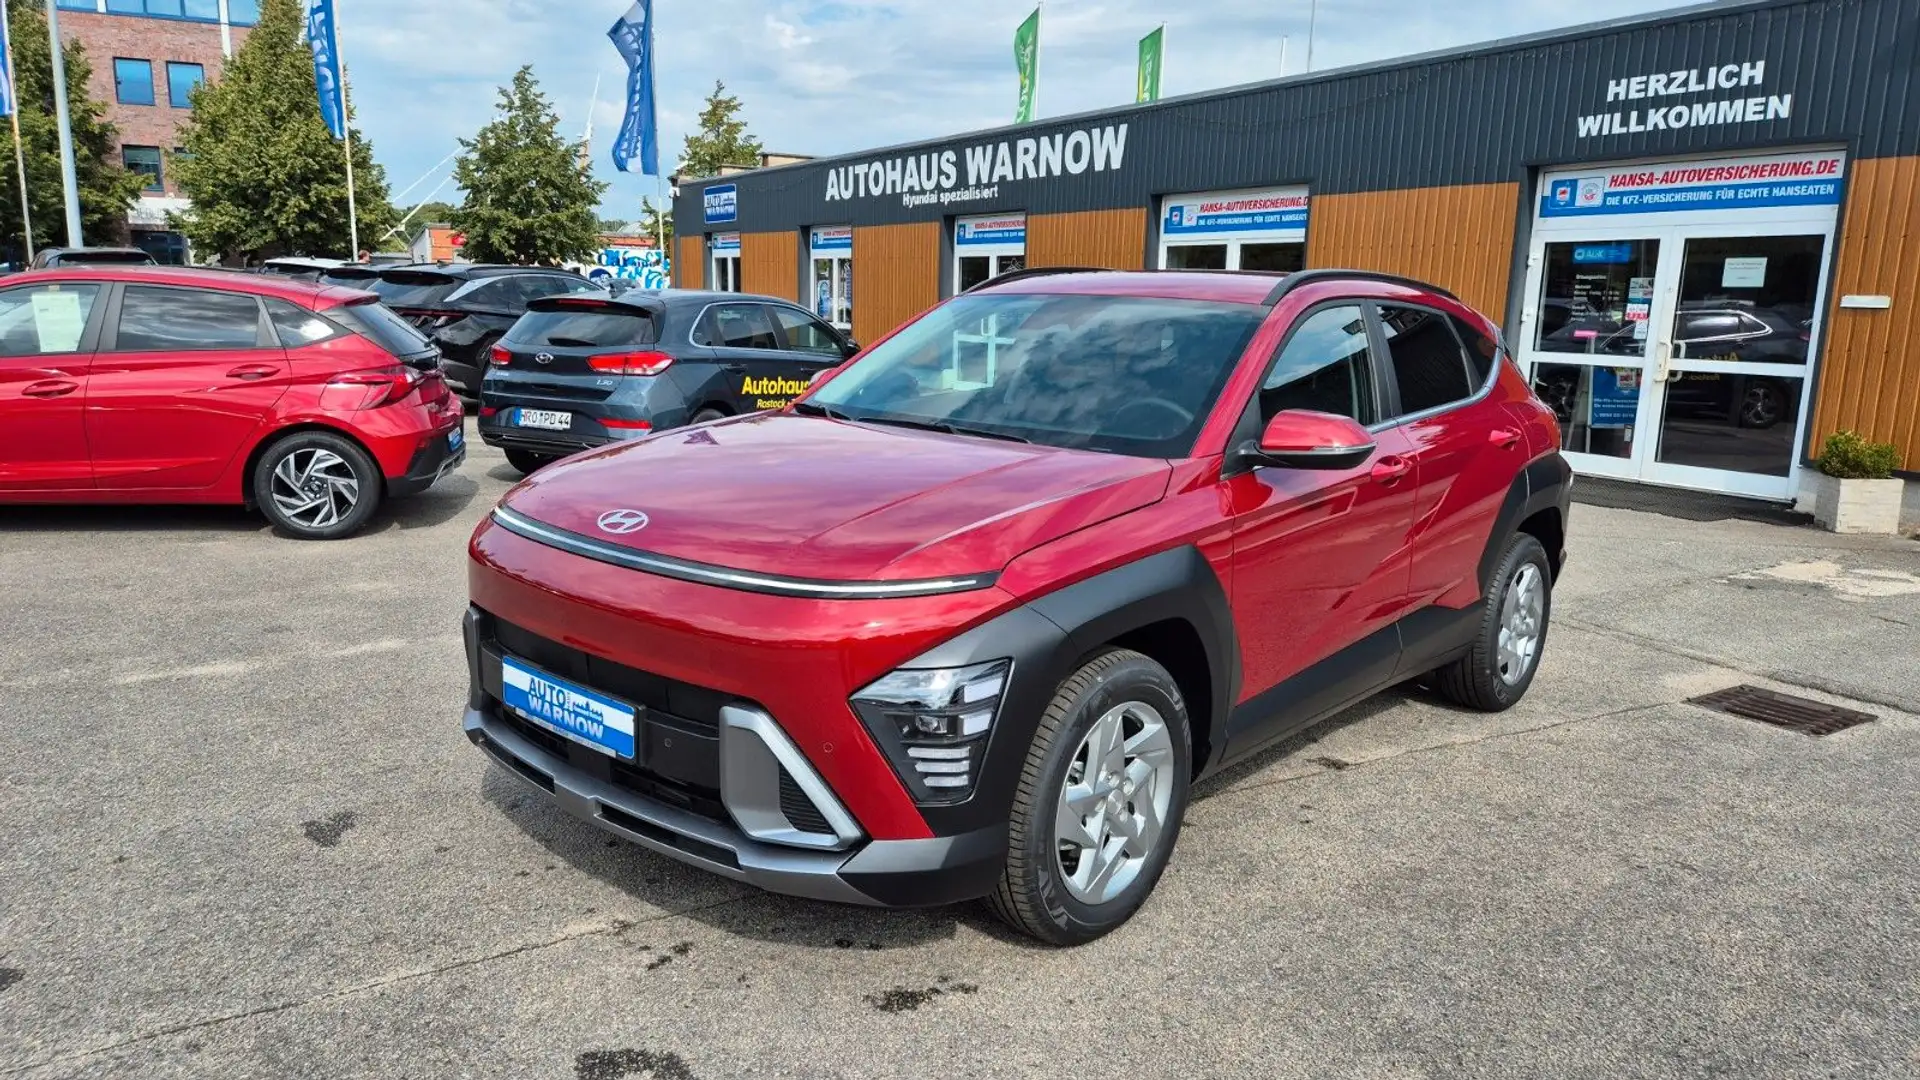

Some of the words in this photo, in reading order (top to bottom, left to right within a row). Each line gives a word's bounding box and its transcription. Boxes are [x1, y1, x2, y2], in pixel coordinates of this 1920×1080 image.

[1606, 60, 1765, 102] HERZLICH
[1577, 94, 1792, 138] WILLKOMMEN
[825, 150, 957, 202] AUTOHAUS
[965, 123, 1128, 188] WARNOW
[1608, 158, 1840, 188] HANSA-AUTOVERSICHERUNG.DE
[902, 191, 938, 208] Hyundai
[939, 184, 999, 205] spezialisiert
[1606, 196, 1620, 206] DIE
[1622, 190, 1713, 206] KFZ-VERSICHERUNG
[1715, 187, 1735, 200] FÜR
[1737, 186, 1770, 199] ECHTE
[1772, 183, 1836, 197] HANSEATEN
[756, 398, 786, 409] Rostock
[558, 414, 570, 426] 44
[528, 677, 566, 707] AUTO
[527, 693, 604, 740] WARNOW
